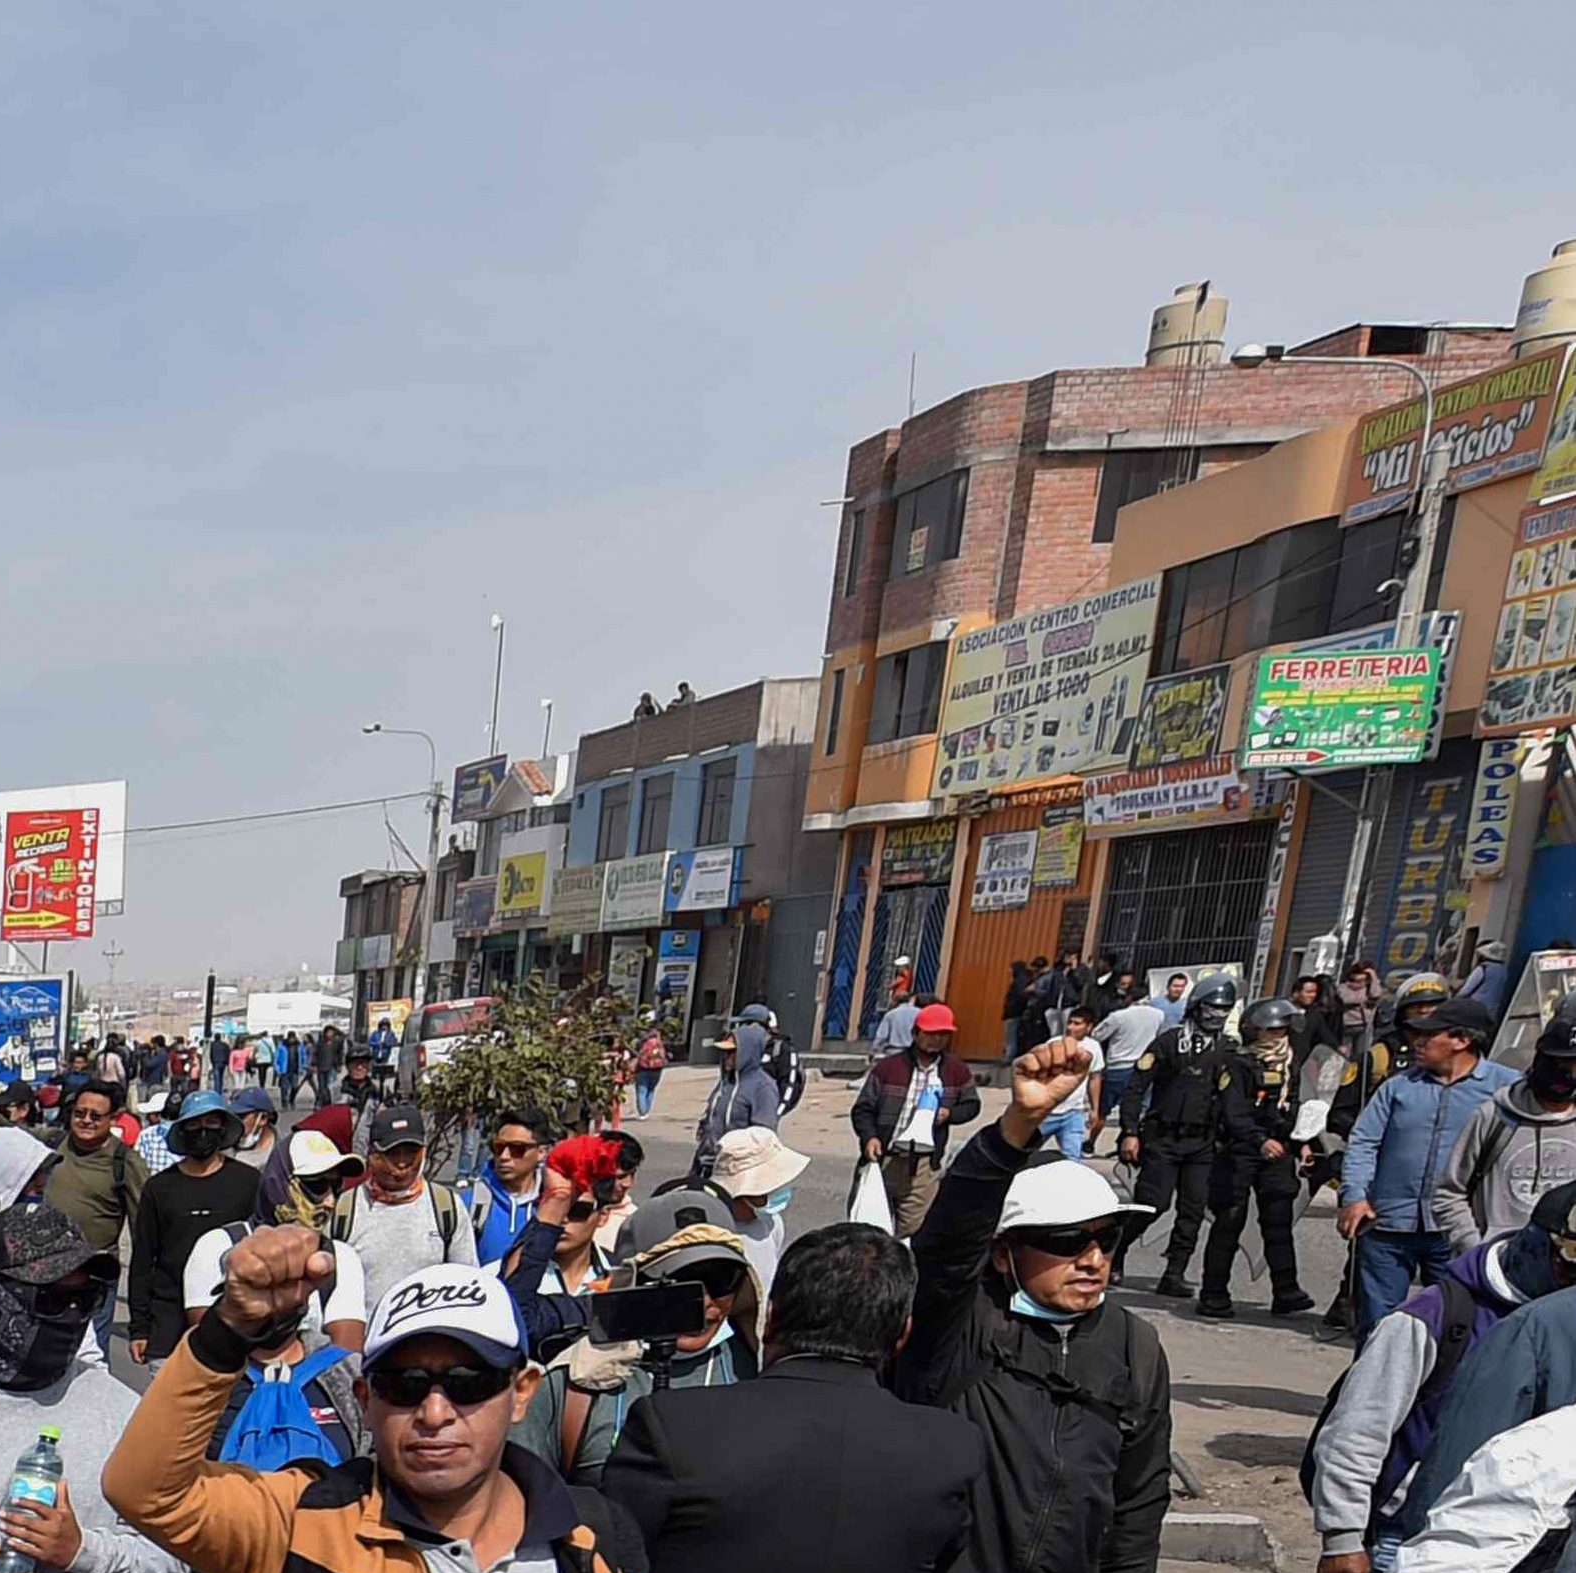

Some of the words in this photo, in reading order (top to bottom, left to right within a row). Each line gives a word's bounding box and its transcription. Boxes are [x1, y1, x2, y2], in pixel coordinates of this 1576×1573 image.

[957, 622, 1026, 655] ASOCIACION
[1030, 602, 1078, 634] CENTRO
[1083, 580, 1156, 617] COMERCIAL
[1006, 666, 1038, 687] VENTA
[1039, 661, 1054, 674] DE
[1269, 654, 1431, 682] FERRETERIA
[993, 690, 1031, 715] VENTA
[1035, 684, 1051, 705] DE
[1057, 673, 1090, 701] TODO
[1469, 741, 1518, 866] POLEAS
[13, 826, 71, 850] VENTA
[76, 810, 97, 932] EXTINTORES
